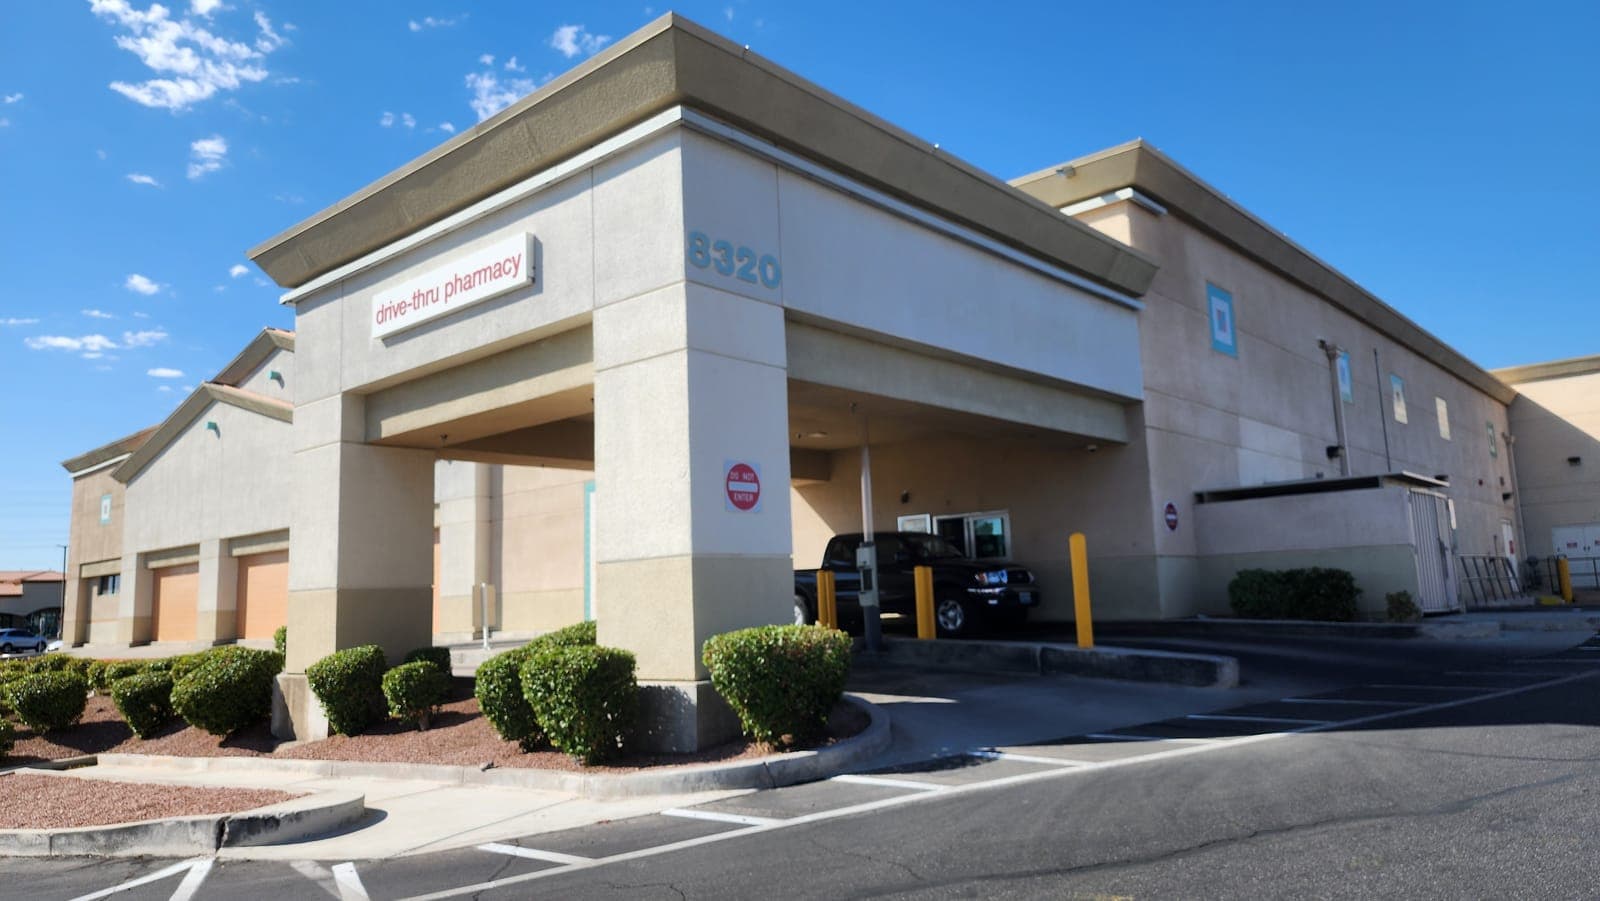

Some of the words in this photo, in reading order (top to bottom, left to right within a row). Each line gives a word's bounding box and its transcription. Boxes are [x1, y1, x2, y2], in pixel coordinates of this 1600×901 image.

[688, 231, 782, 289] 8320
[376, 286, 439, 325] drive-thru
[444, 253, 521, 304] pharmacy
[730, 471, 739, 480] DO
[743, 471, 755, 481] NOT
[733, 492, 754, 502] ENTER
